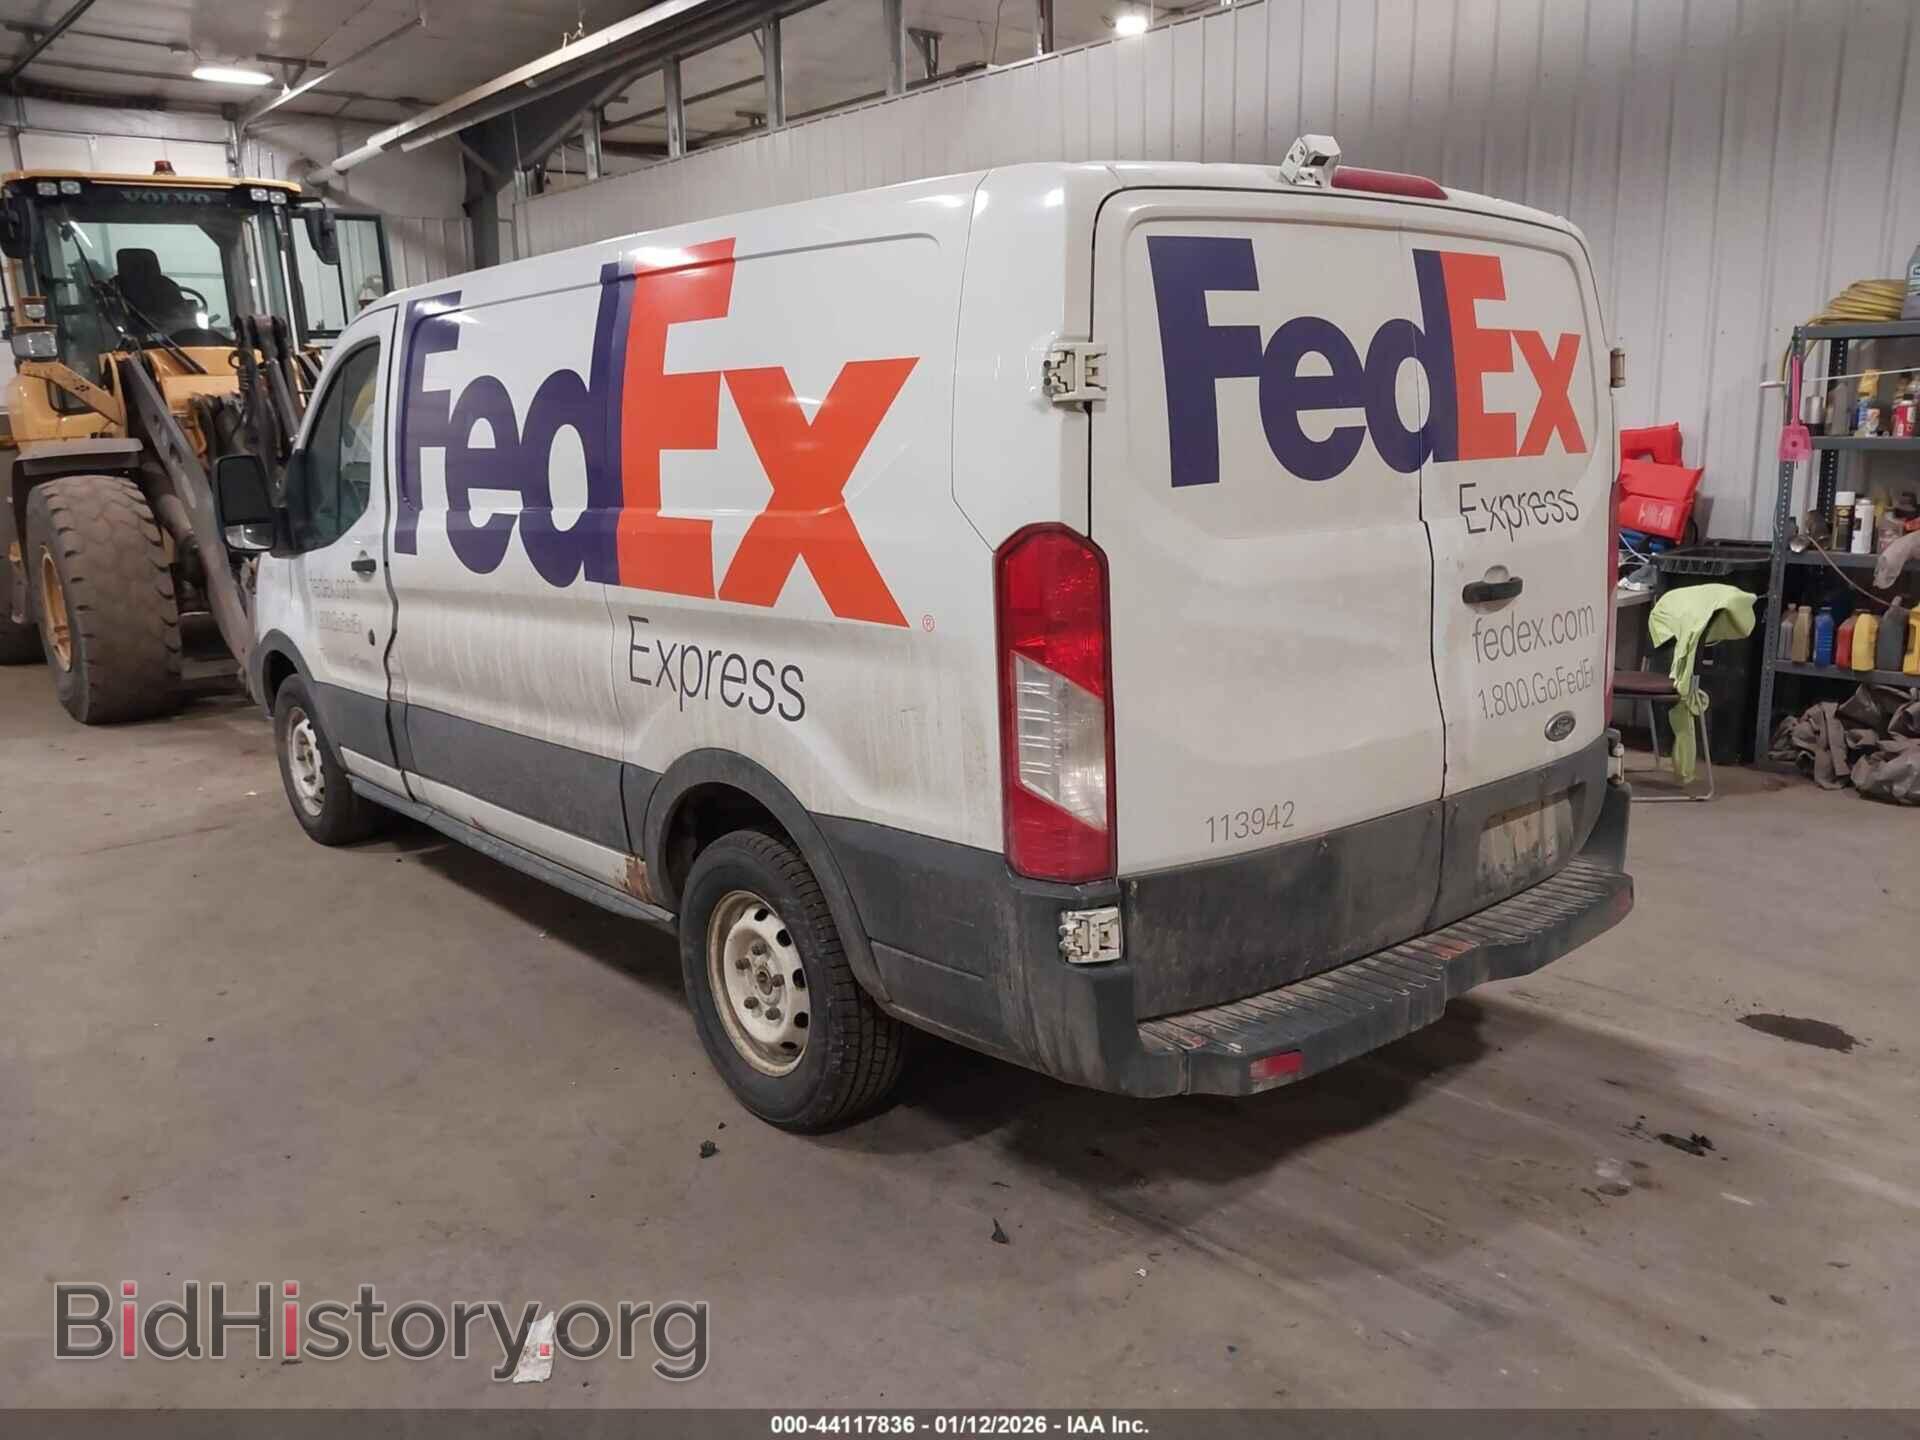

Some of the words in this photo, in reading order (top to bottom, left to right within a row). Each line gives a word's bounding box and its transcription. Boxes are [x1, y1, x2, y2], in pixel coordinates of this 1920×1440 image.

[1146, 235, 1588, 488] FedEx
[395, 237, 920, 628] FedEx
[1459, 482, 1580, 542] Express
[627, 615, 806, 722] Express
[1472, 604, 1595, 663] fedex.com
[1205, 801, 1295, 843] 113942
